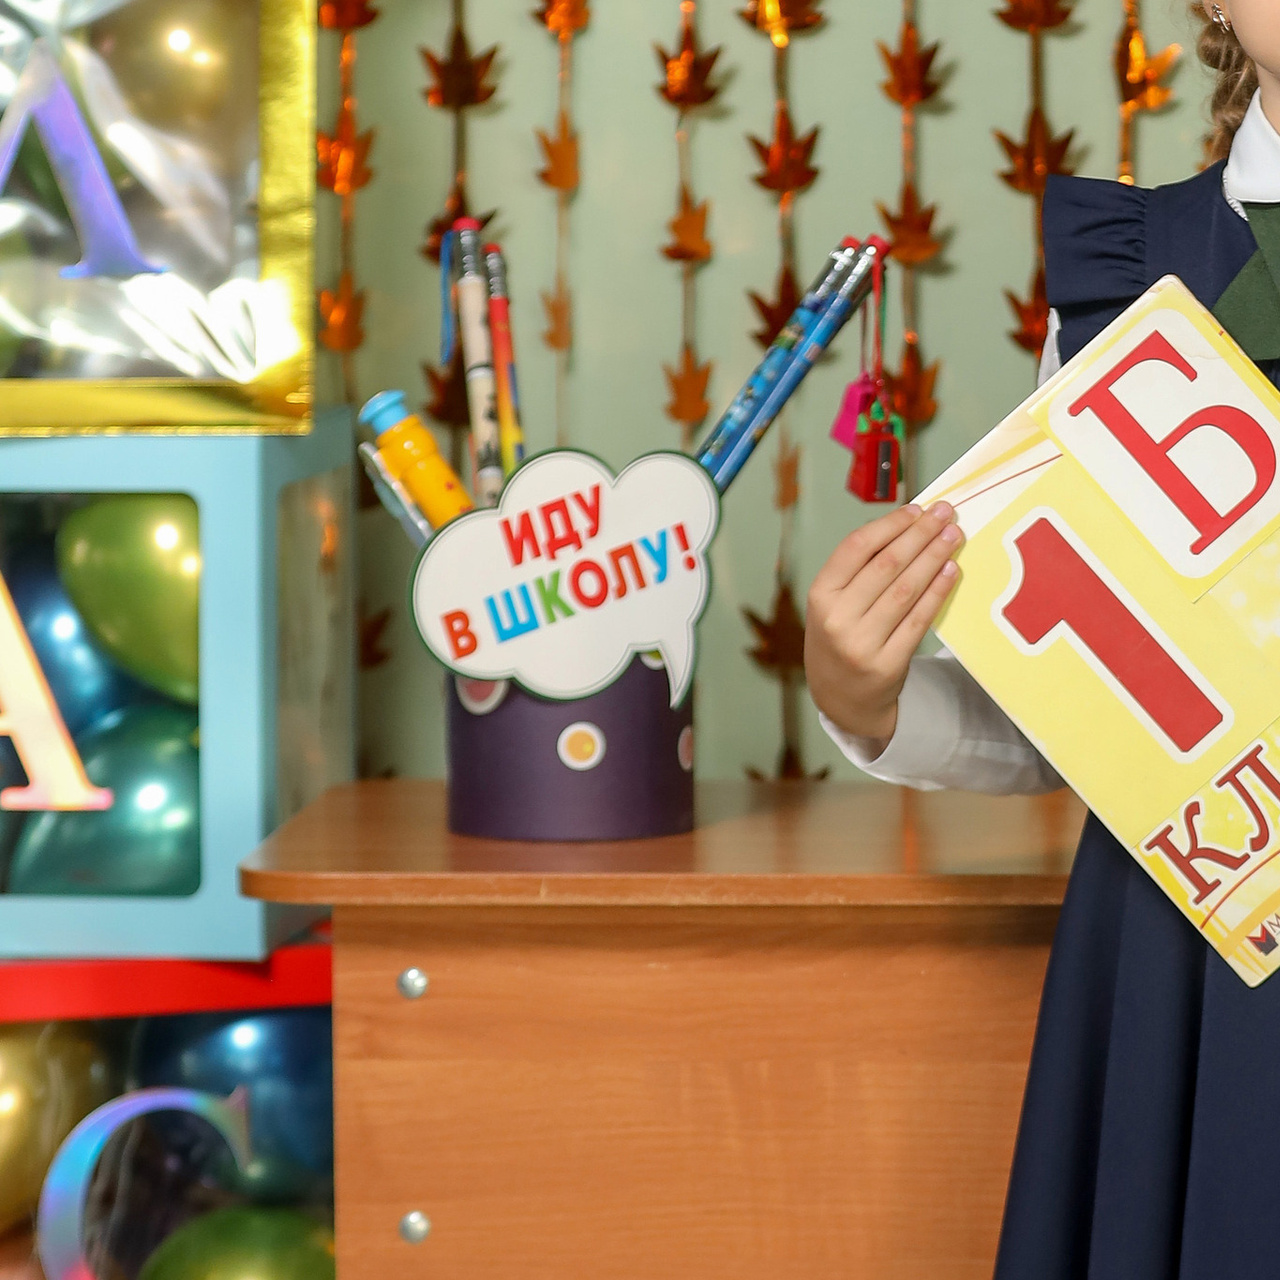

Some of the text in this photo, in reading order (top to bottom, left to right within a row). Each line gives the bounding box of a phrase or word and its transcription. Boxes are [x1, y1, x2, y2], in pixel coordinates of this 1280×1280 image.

[441, 522, 697, 661] В ШКОЛУ!
[501, 482, 601, 567] ИДУ
[1001, 329, 1277, 754] 1 Б
